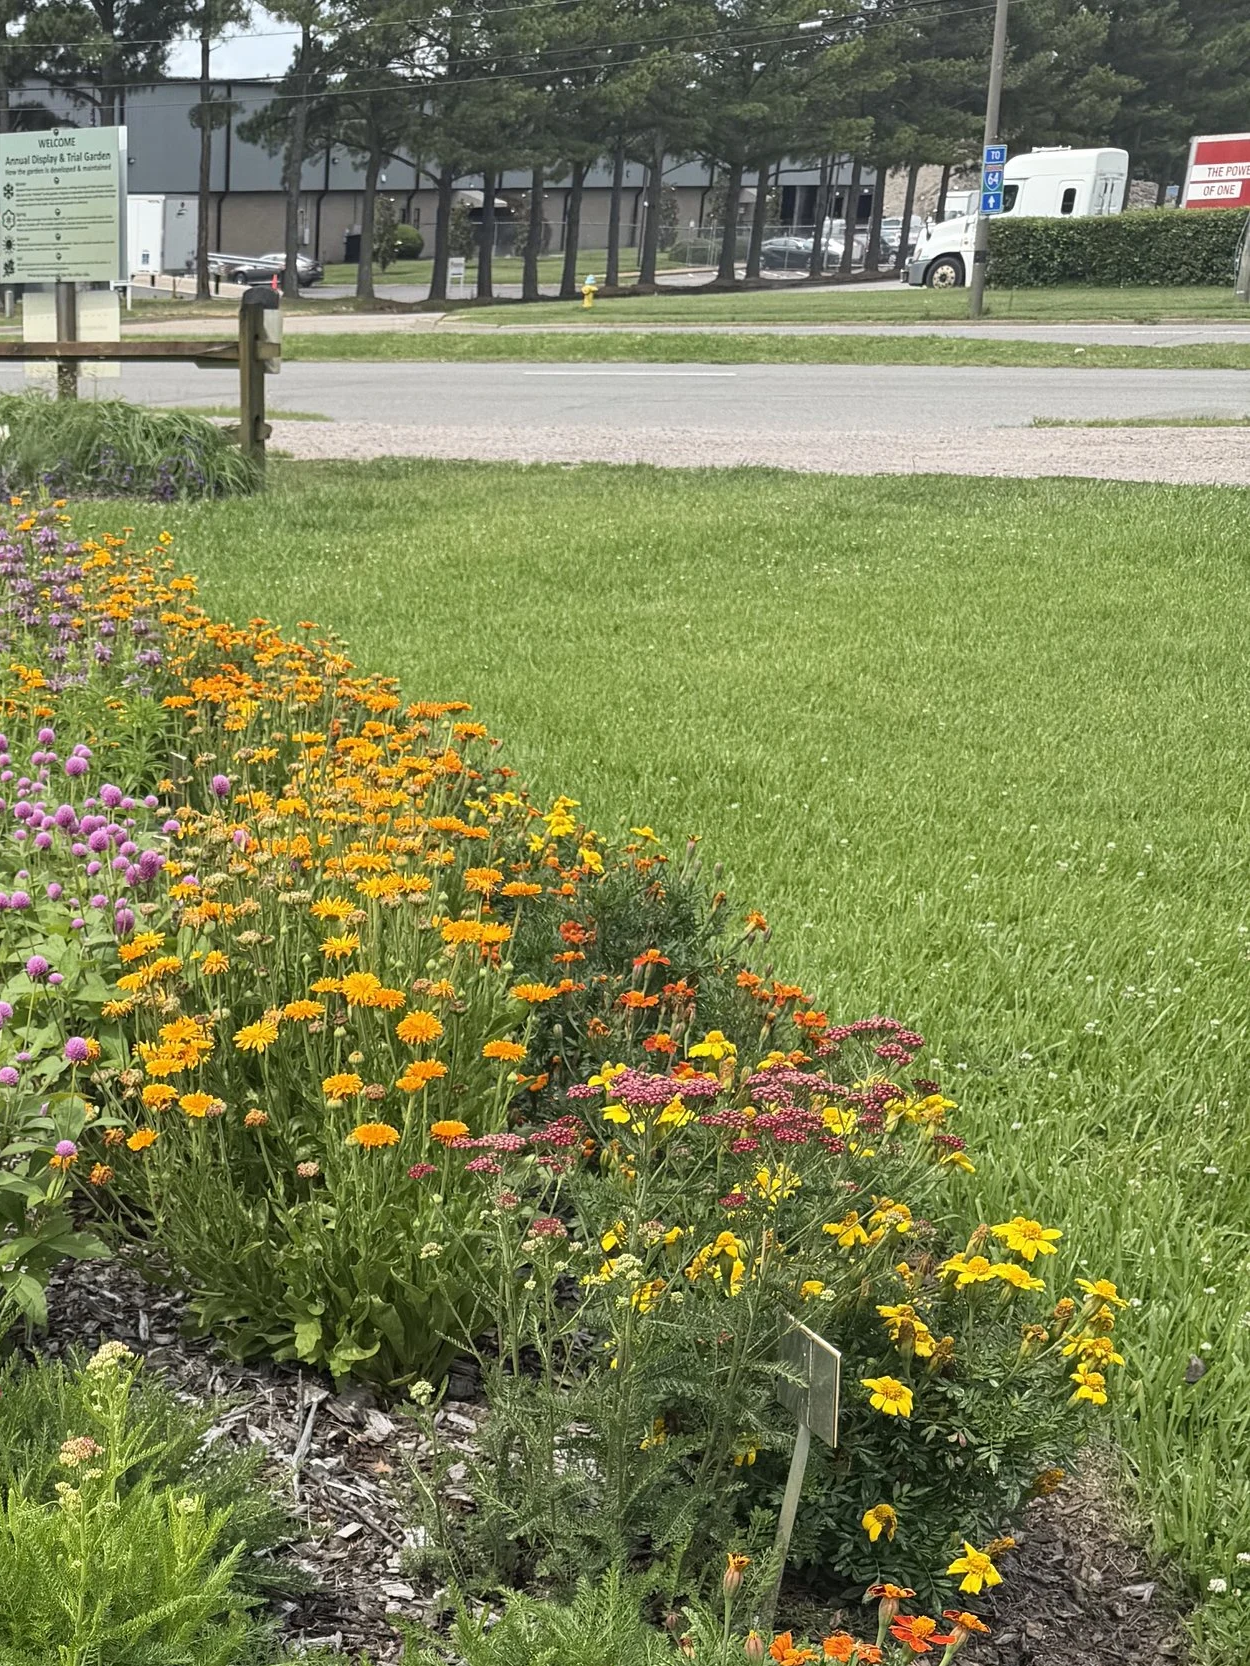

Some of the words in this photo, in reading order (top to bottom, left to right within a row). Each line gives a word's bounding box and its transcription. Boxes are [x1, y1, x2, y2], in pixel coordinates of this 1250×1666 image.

[38, 137, 76, 148] WELCOME
[5, 155, 30, 166] Annual
[32, 153, 58, 165] Display
[59, 153, 65, 162] &
[66, 152, 82, 162] Trial
[84, 151, 111, 161] Garden
[990, 151, 1001, 160] TO
[1207, 167, 1225, 178] THE
[1225, 165, 1250, 177] POWE
[987, 172, 999, 186] 64
[1203, 185, 1216, 196] OF
[1217, 184, 1236, 196] ONE
